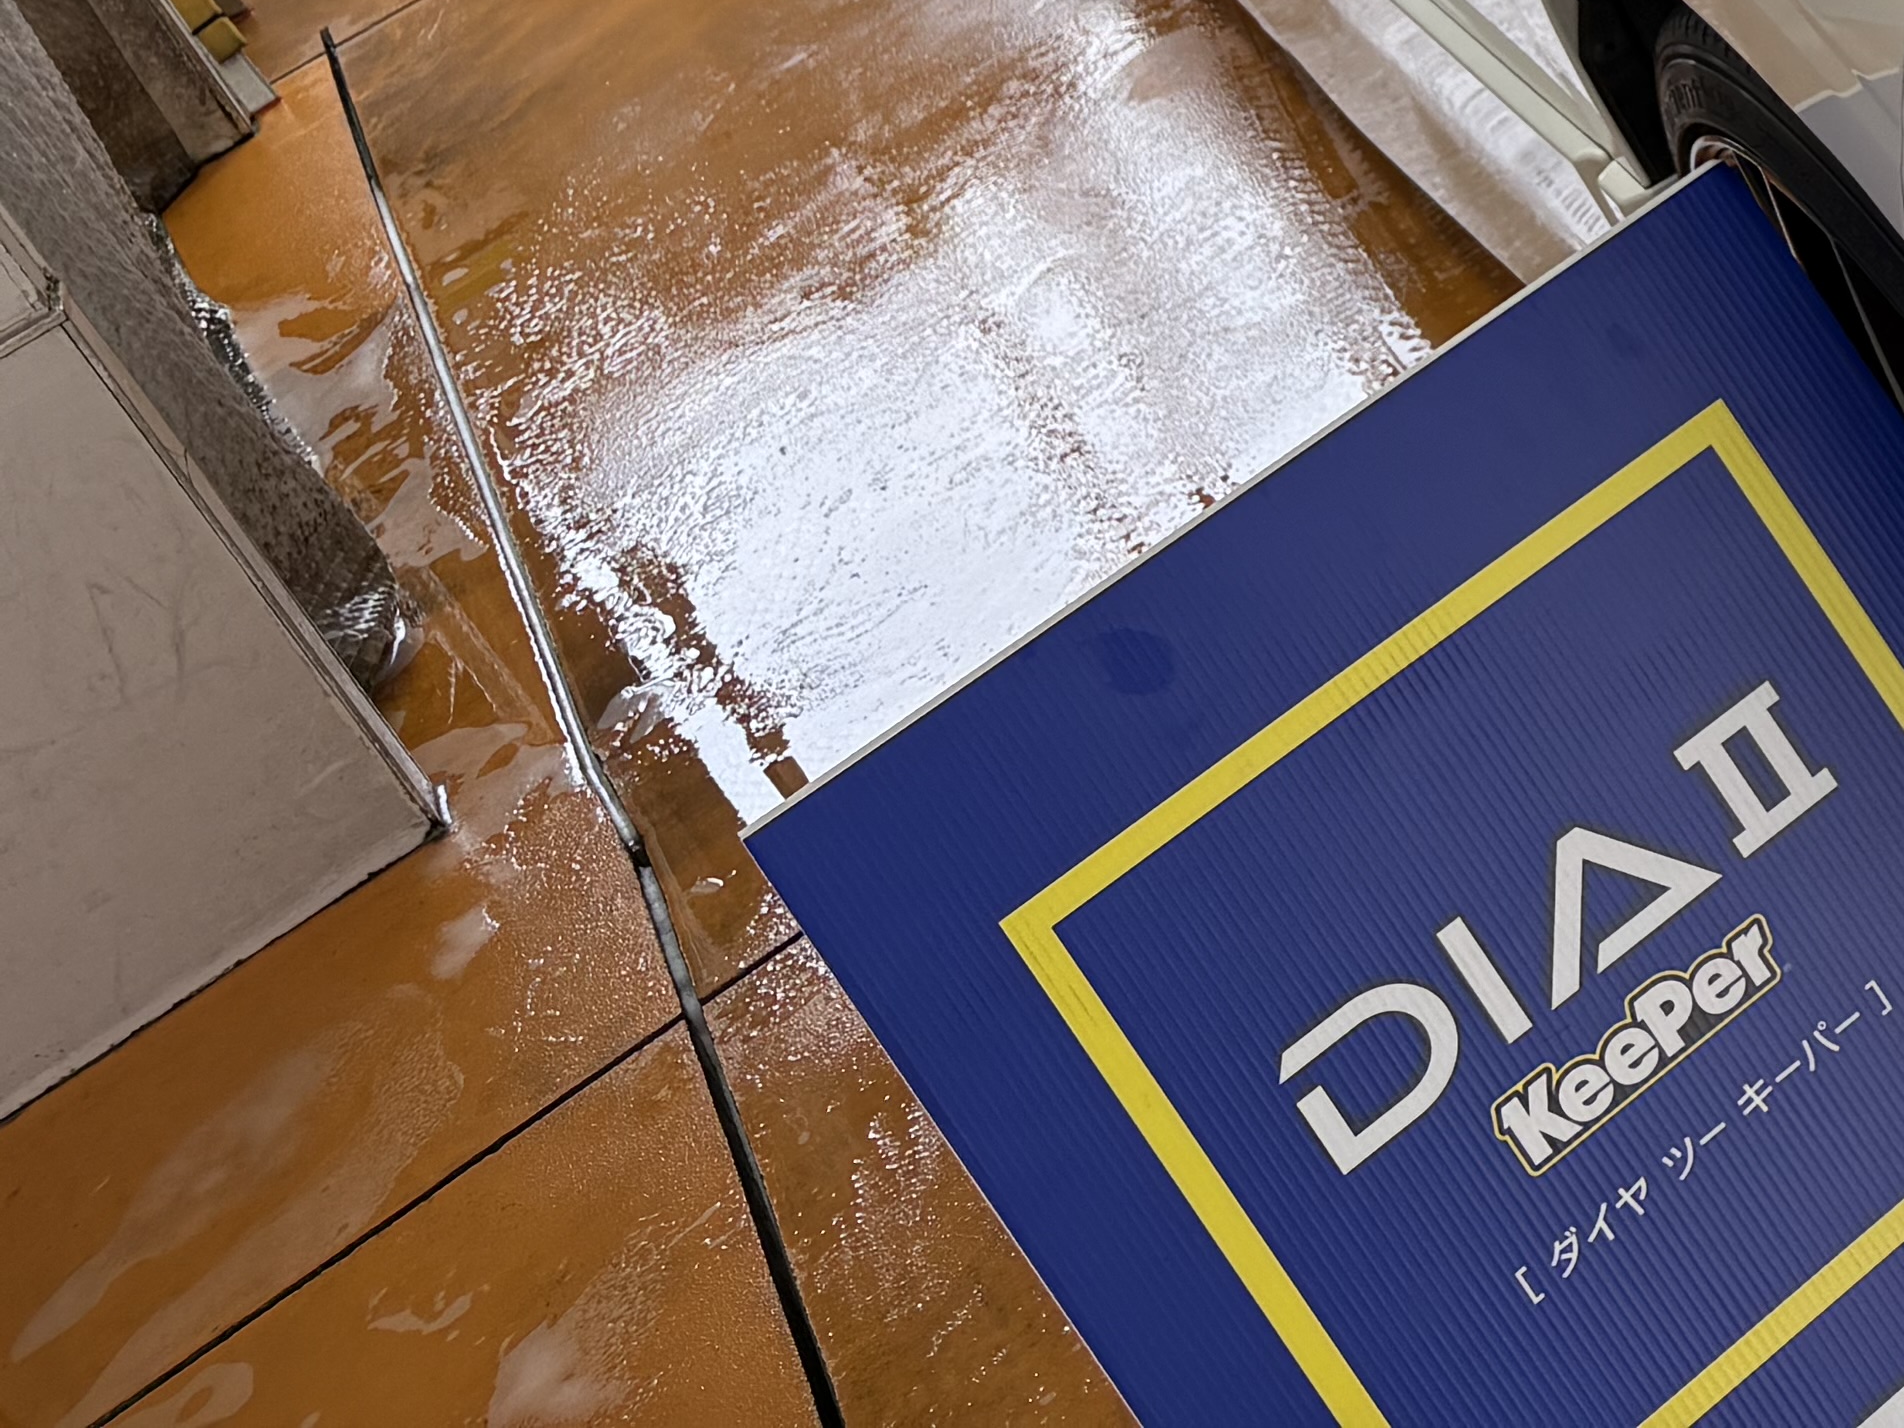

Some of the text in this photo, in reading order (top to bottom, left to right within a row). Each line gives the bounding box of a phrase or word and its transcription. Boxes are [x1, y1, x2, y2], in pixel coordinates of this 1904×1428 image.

[1491, 913, 1781, 1177] KeePer
[1551, 1175, 1648, 1278] ダイヤ
[1737, 1011, 1861, 1116] キーパー
